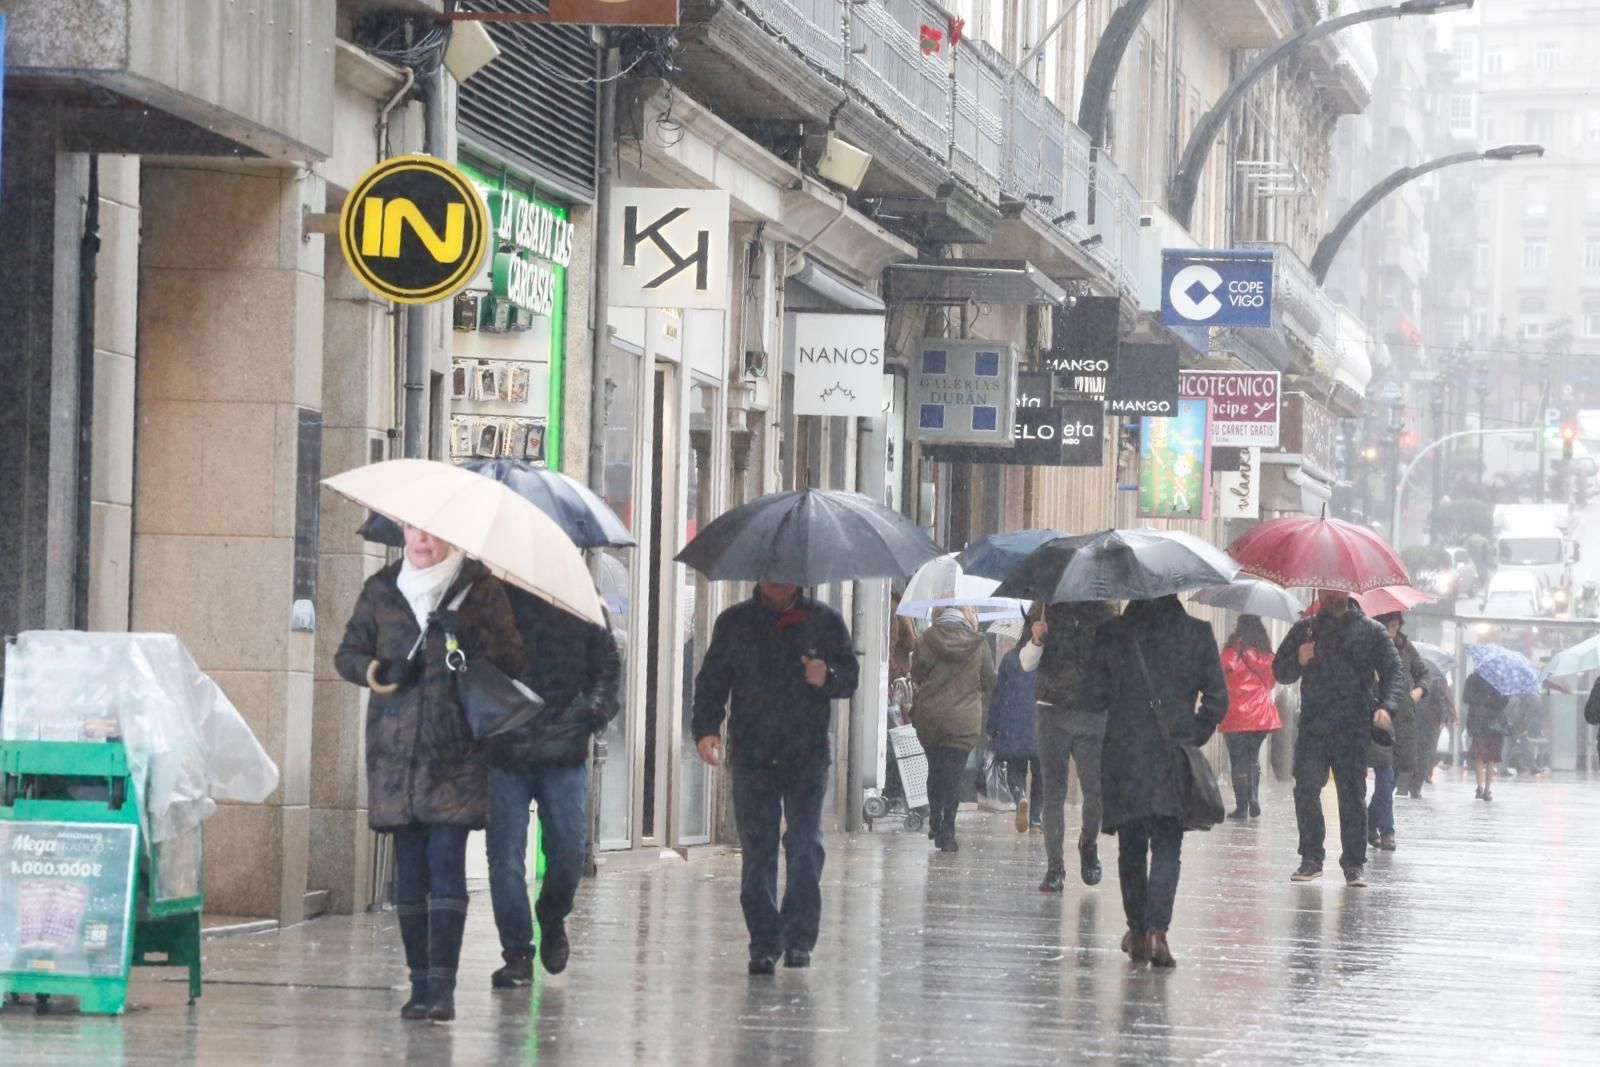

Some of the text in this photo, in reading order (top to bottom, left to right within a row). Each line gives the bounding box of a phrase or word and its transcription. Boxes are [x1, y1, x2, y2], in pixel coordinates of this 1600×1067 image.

[362, 197, 466, 263] IN
[498, 190, 513, 241] LA
[516, 198, 540, 254] CASA
[553, 217, 574, 268] LAS
[508, 253, 556, 317] CARCASAS
[1229, 281, 1264, 293] COPE
[1229, 295, 1264, 307] VIGO
[800, 347, 880, 365] NANOS
[1046, 359, 1109, 372] MANGO
[1112, 400, 1170, 412] MANGO
[1063, 420, 1094, 437] eta
[1222, 424, 1248, 437] CARNET
[1250, 425, 1274, 437] GRATIS
[12, 834, 57, 856] Mega
